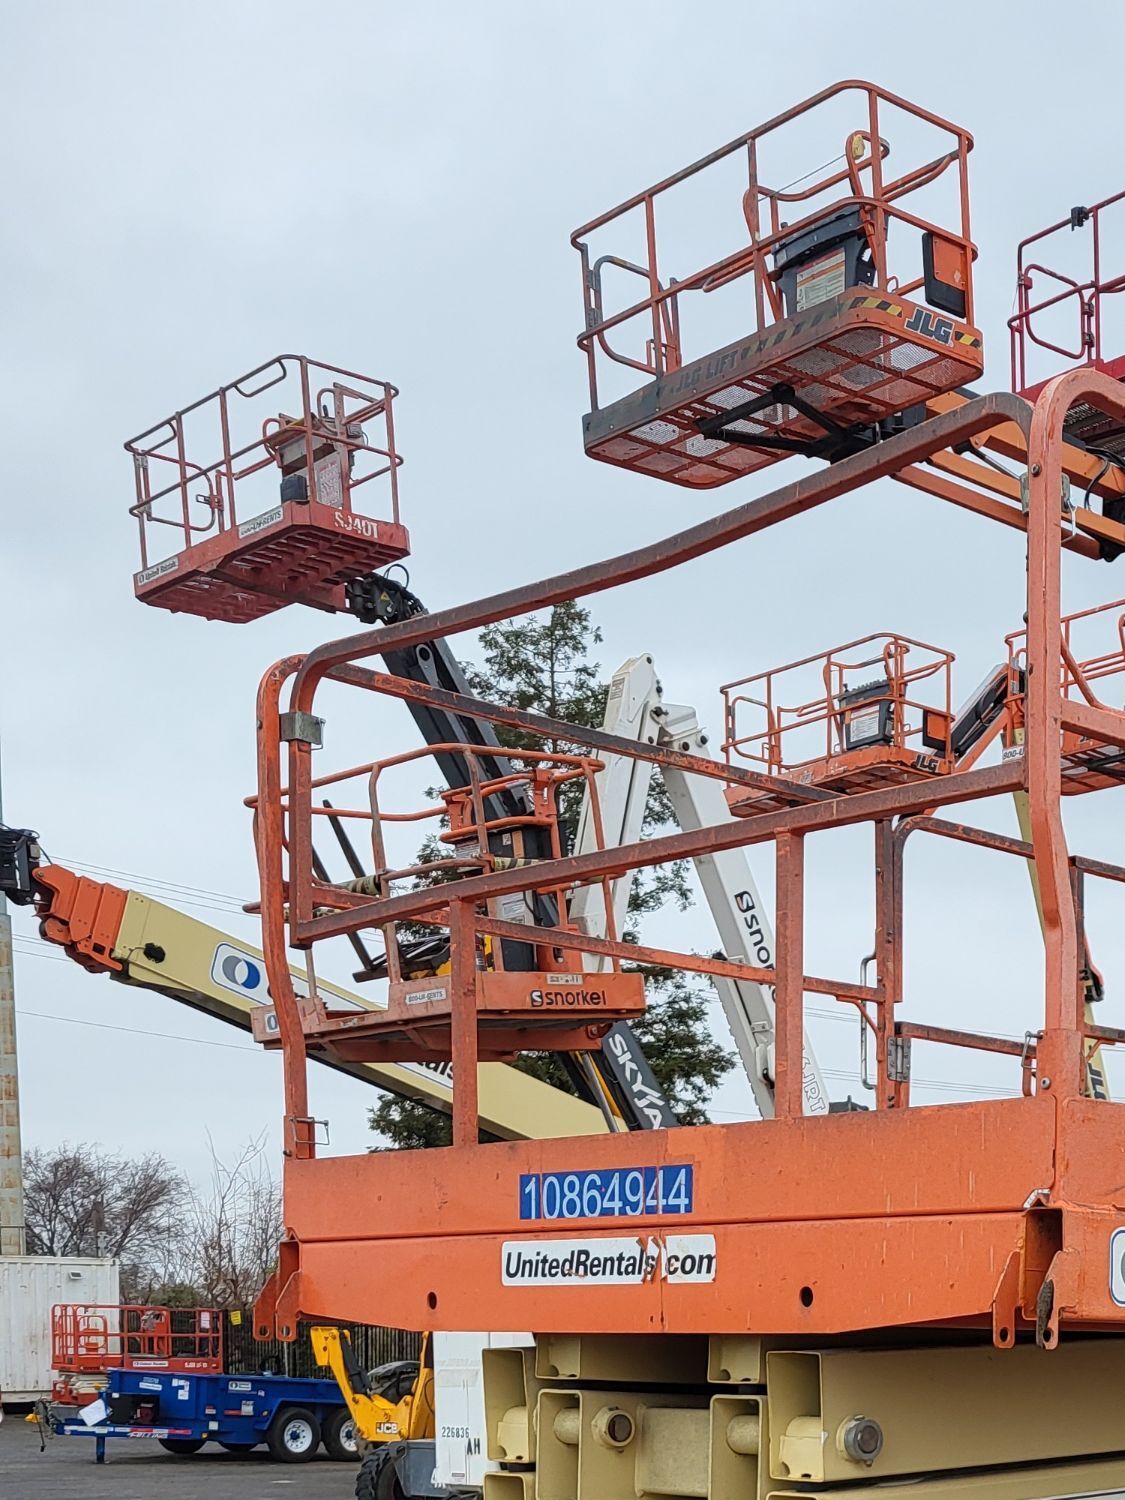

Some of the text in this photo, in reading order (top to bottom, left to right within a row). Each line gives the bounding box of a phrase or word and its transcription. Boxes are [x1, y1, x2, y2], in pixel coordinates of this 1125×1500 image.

[906, 307, 953, 345] JLG
[911, 754, 939, 776] JLG
[545, 990, 607, 1006] snorkel
[608, 1033, 666, 1130] SKYJA
[524, 1168, 690, 1220] 10864944
[376, 1422, 399, 1434] JCB
[441, 1425, 470, 1439] 226836
[466, 1437, 481, 1456] AH
